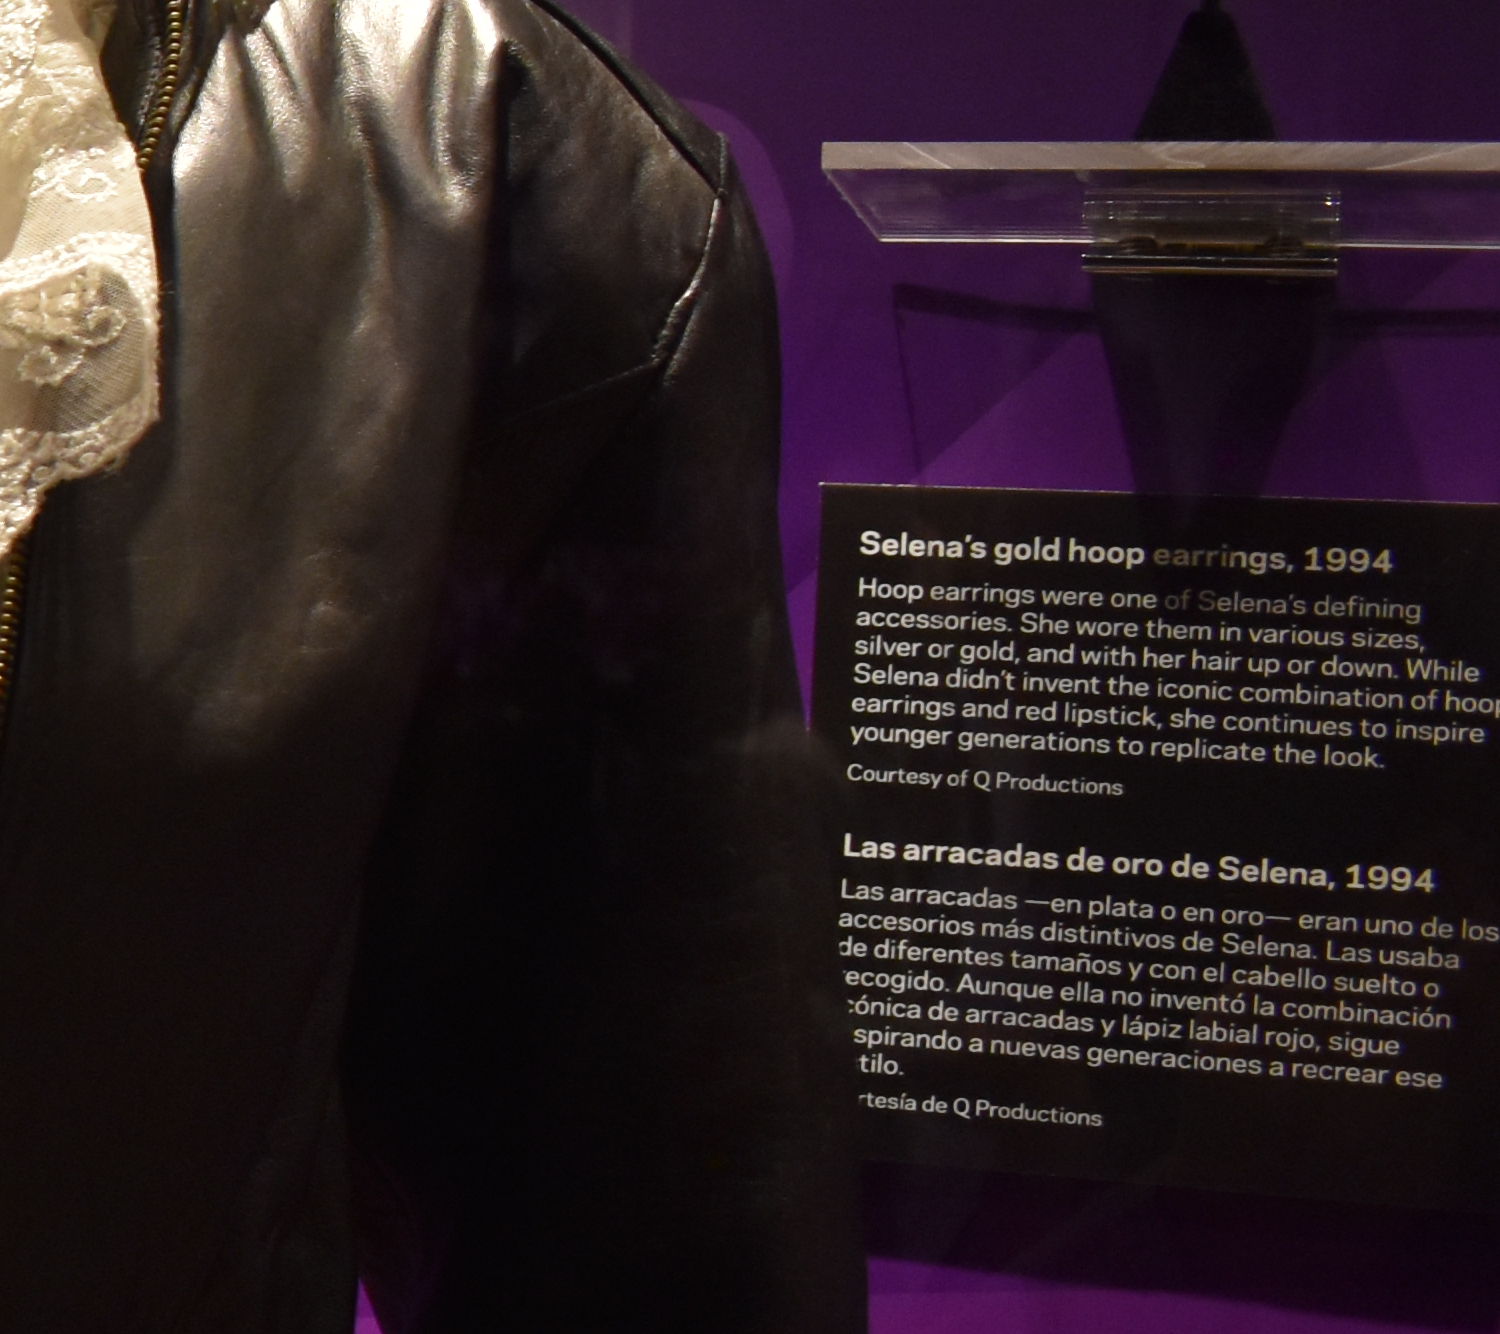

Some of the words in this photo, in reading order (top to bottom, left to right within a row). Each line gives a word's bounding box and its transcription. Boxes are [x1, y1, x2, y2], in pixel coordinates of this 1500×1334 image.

[859, 529, 987, 559] Selena's
[993, 535, 1061, 565] gold
[1068, 536, 1145, 569] hoop
[1152, 543, 1294, 574] earrings,
[1305, 546, 1393, 573] 1994
[858, 576, 925, 605] Hoop
[929, 581, 1035, 608] earrings
[1041, 588, 1104, 607] were
[1110, 591, 1158, 609] one
[1163, 588, 1192, 611] of
[1198, 589, 1307, 615] Selena's
[1313, 595, 1421, 624] defining
[855, 610, 1013, 632] accessories.
[1019, 613, 1070, 635] She
[1075, 619, 1139, 638] wore
[1145, 618, 1212, 641] them
[1219, 622, 1242, 641] in
[1248, 625, 1345, 647] various
[1351, 631, 1425, 652] sizes,
[854, 635, 923, 657] silver
[927, 642, 955, 659] or
[959, 640, 1021, 665] gold,
[1026, 643, 1075, 665] and
[1080, 645, 1137, 667] with
[1142, 647, 1186, 669] her
[1191, 649, 1243, 671] hair
[1247, 657, 1281, 678] up
[1287, 658, 1315, 675] or
[1321, 654, 1398, 679] down.
[1406, 657, 1480, 682] While
[853, 663, 940, 687] Selena
[945, 667, 1016, 690] didn't
[1022, 670, 1101, 695] invent
[1107, 674, 1150, 697] the
[1157, 677, 1233, 701] iconic
[1239, 682, 1404, 708] combination
[1410, 688, 1438, 710] of
[851, 693, 956, 721] earrings
[961, 698, 1009, 720] and
[1015, 700, 1058, 722] red
[1064, 701, 1162, 730] lipstick,
[1169, 706, 1216, 730] she
[1222, 712, 1353, 737] continues
[1360, 718, 1387, 739] to
[1395, 718, 1485, 745] inspire
[850, 725, 953, 750] younger
[957, 730, 1111, 754] generations
[1116, 736, 1144, 755] to
[1150, 736, 1266, 762] replicate
[1272, 741, 1317, 764] the
[1324, 743, 1384, 768] look.
[846, 762, 943, 790] Courtesy
[946, 768, 969, 787] of
[973, 769, 991, 792] Q
[995, 771, 1124, 795] Productions
[843, 832, 896, 860] Las
[902, 841, 1059, 870] arracadas
[1066, 845, 1105, 873] de
[1112, 855, 1164, 877] oro
[1170, 851, 1210, 879] de
[1218, 855, 1335, 890] Selena,
[1346, 863, 1435, 892] 1994
